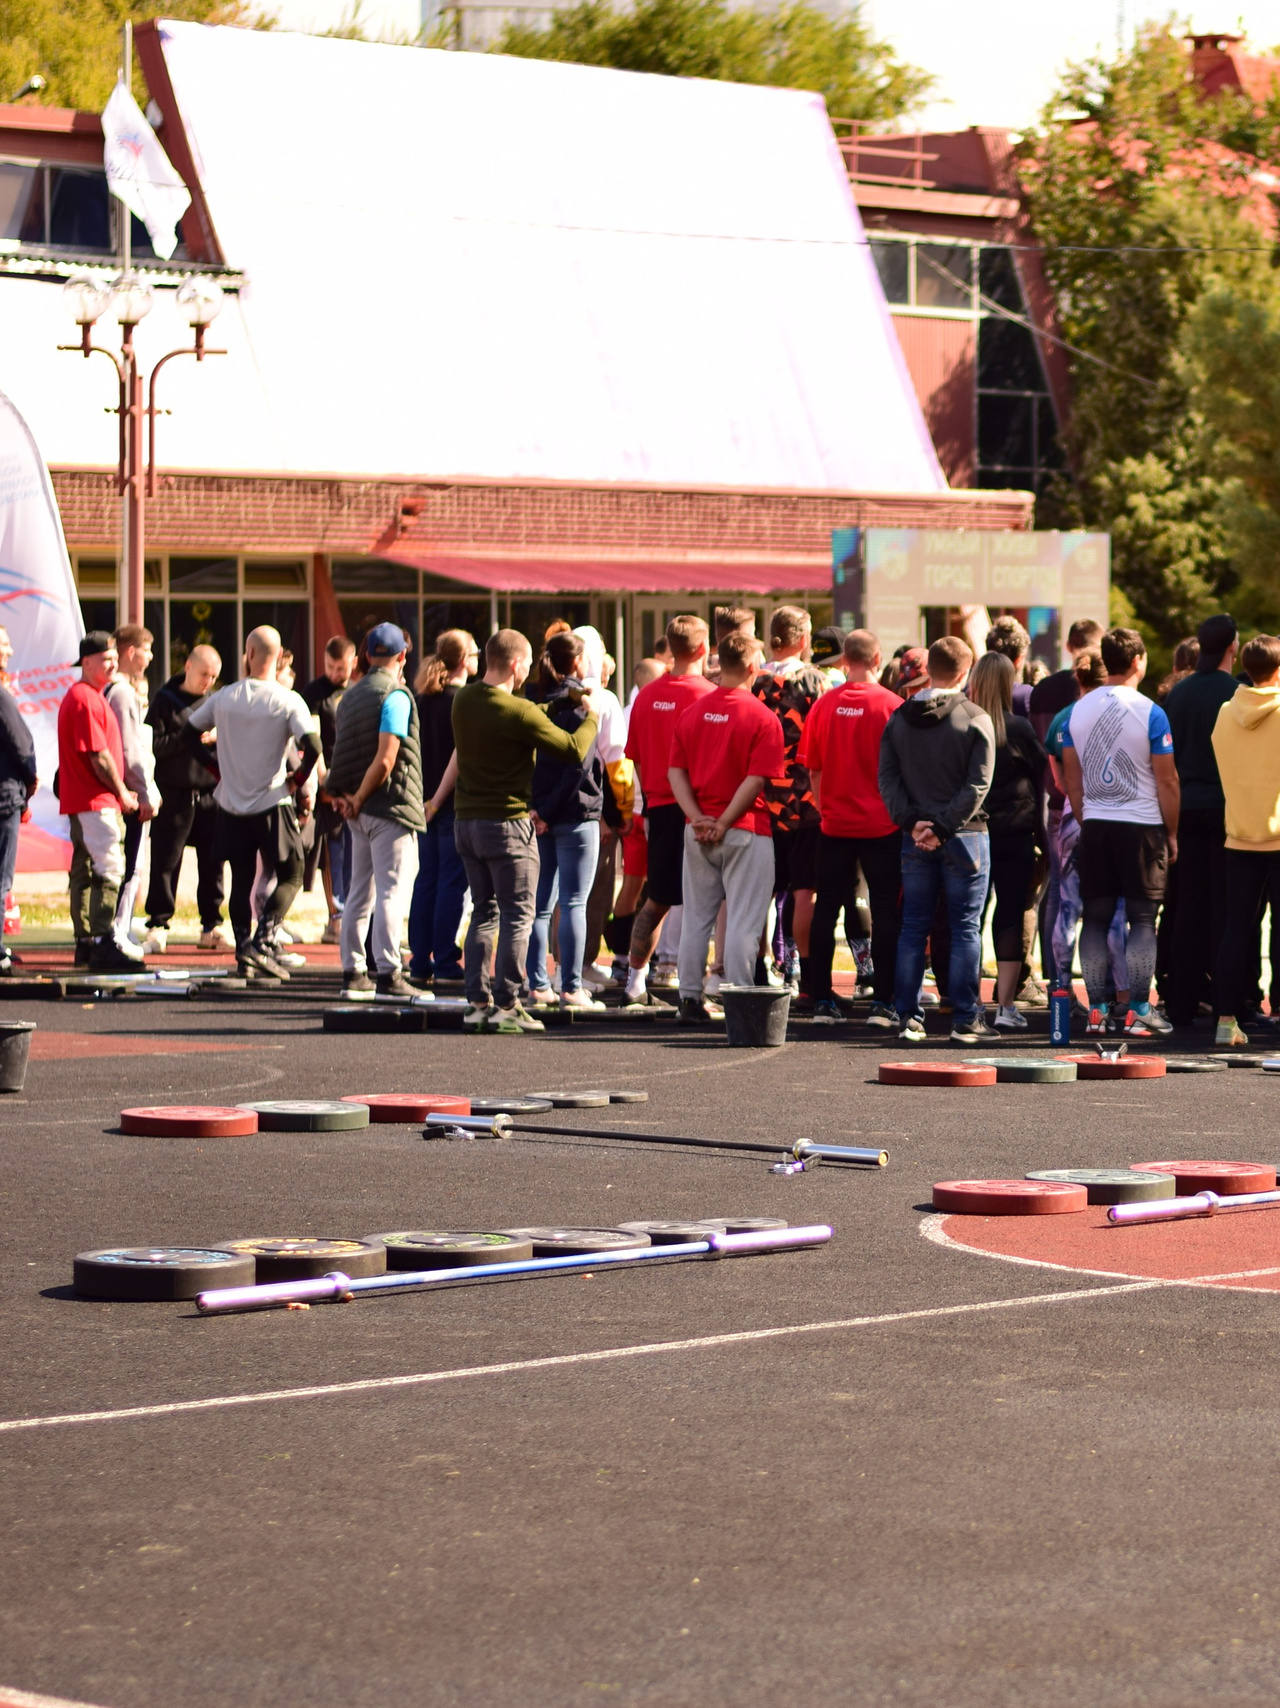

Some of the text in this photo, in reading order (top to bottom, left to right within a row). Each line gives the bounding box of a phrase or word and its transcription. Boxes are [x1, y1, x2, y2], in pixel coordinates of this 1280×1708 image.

[925, 565, 971, 590] ГОРОД
[653, 701, 676, 711] СУДЬЯ
[836, 706, 864, 717] СУДЬЯ
[704, 712, 729, 722] СУДЬЯ
